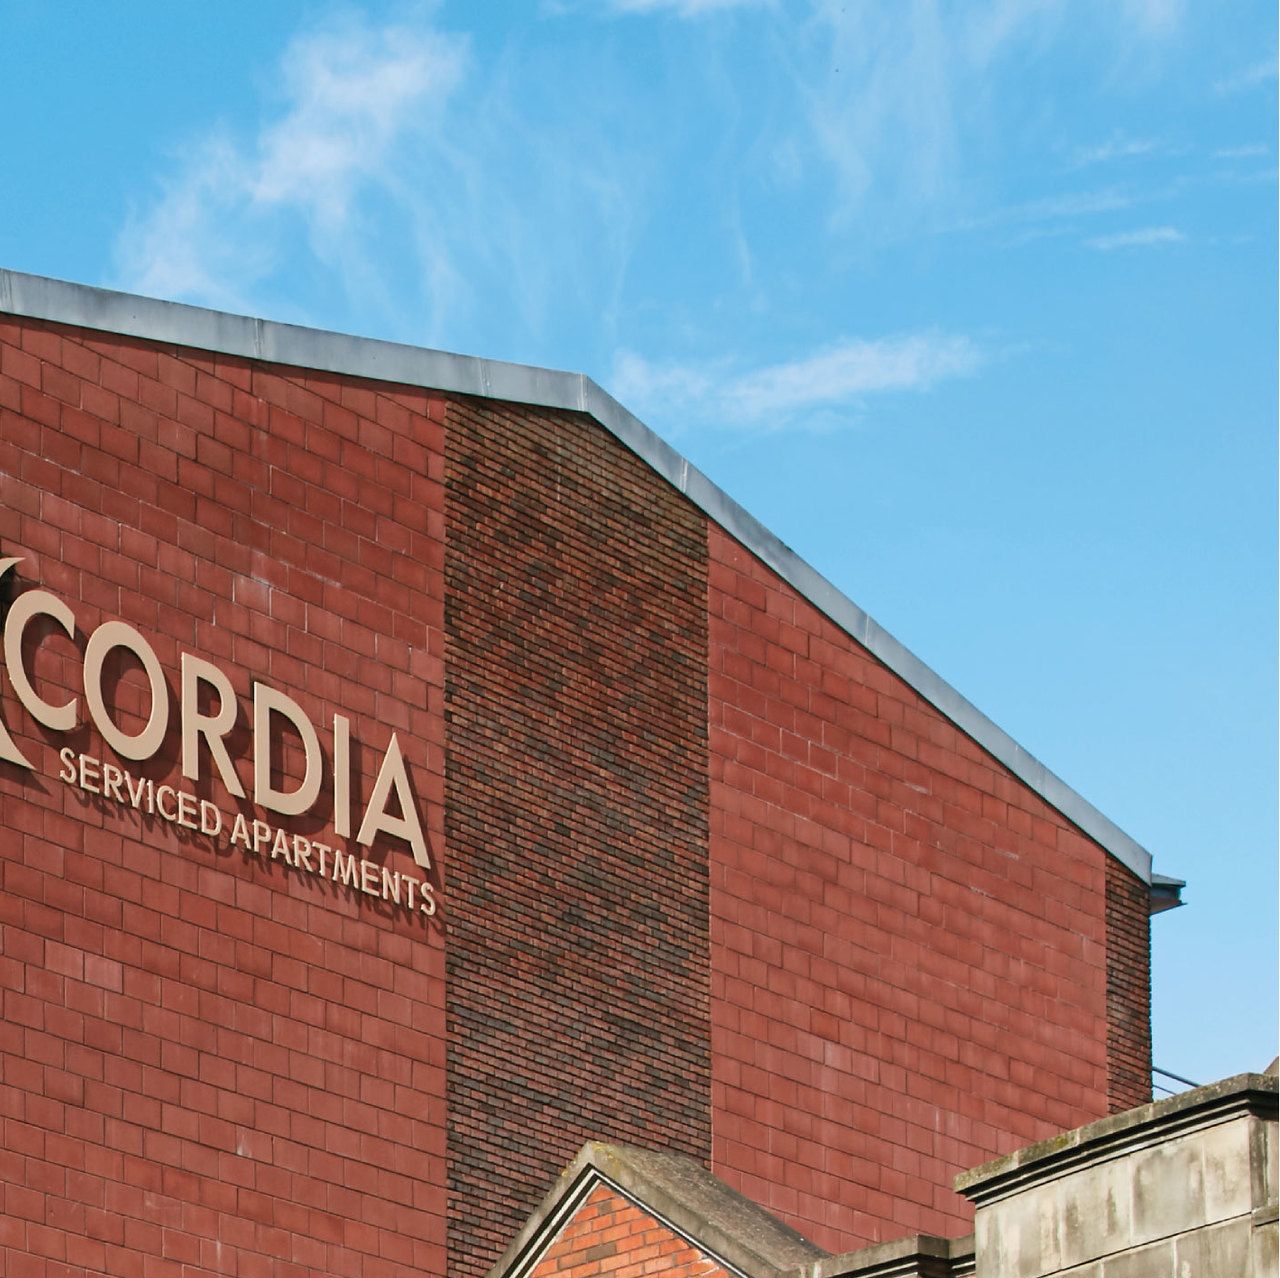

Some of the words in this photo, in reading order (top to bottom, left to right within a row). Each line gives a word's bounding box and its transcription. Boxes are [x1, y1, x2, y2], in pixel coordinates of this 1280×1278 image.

[3, 589, 431, 870] CORDIA
[59, 746, 222, 836] SERVICED
[230, 813, 437, 916] APARTMENTS
